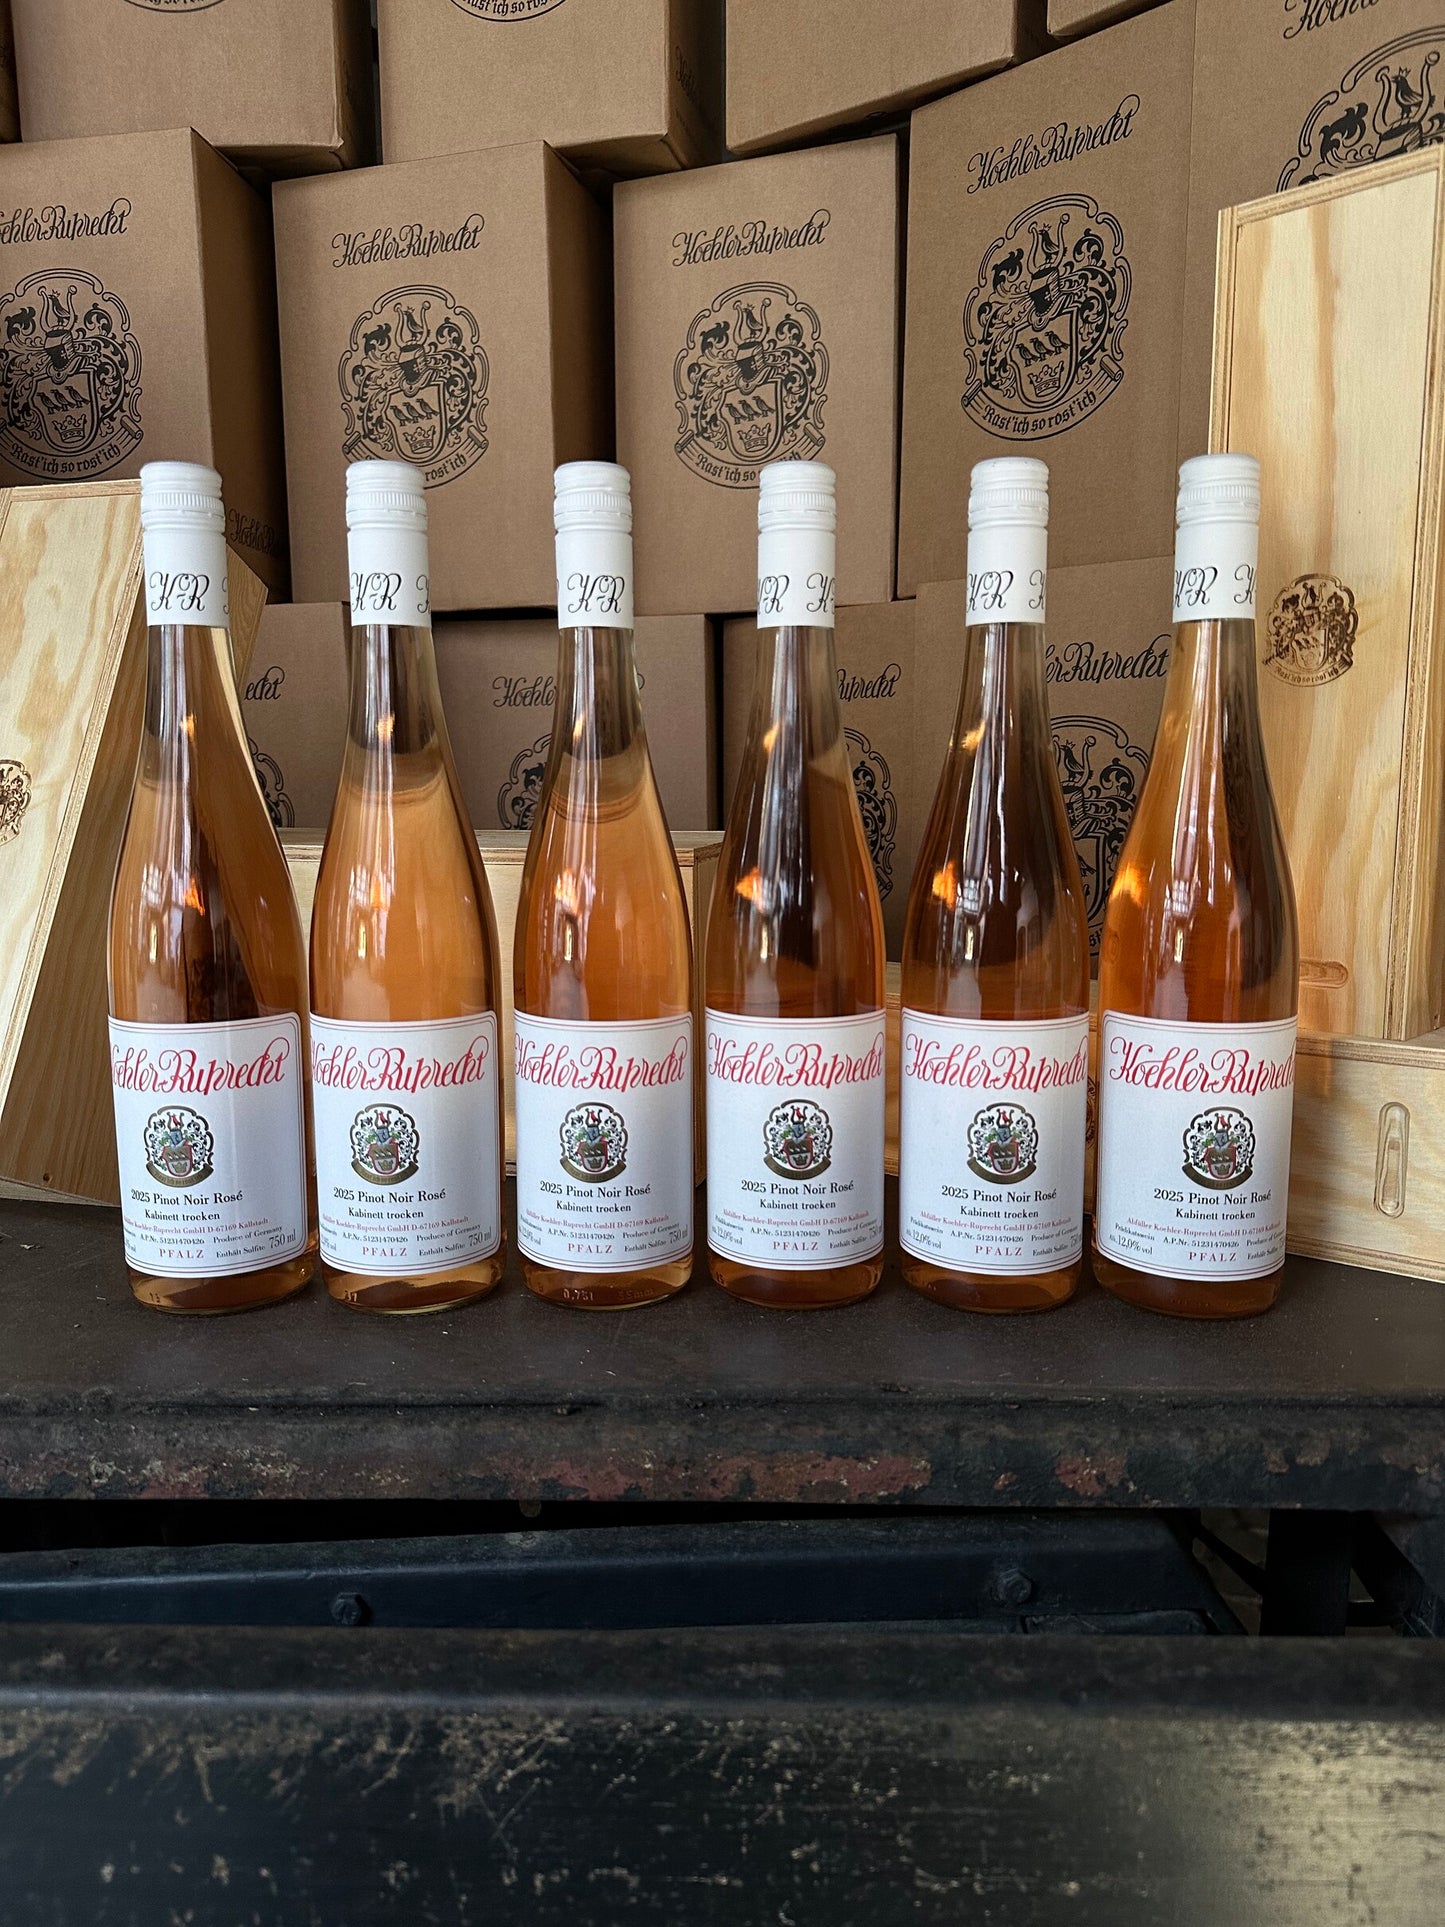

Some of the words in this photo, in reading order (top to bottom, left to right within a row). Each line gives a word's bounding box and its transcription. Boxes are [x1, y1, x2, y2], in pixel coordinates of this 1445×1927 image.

[1031, 420, 1045, 431] so
[60, 464, 75, 473] so
[540, 1180, 562, 1194] 2025
[566, 1185, 593, 1198] Pinot
[597, 1187, 622, 1198] Noir
[625, 1183, 651, 1197] Rosé
[741, 1180, 766, 1193] 2025
[770, 1183, 799, 1195] Pinot
[803, 1184, 826, 1194] Noir
[830, 1180, 854, 1193] Rosé
[941, 1185, 968, 1199] 2025
[973, 1190, 1002, 1203] Pinot
[1007, 1191, 1031, 1203] Noir
[1034, 1188, 1057, 1201] Rosé
[131, 1189, 150, 1203] 2025
[153, 1193, 179, 1205] Pinot
[184, 1194, 210, 1206] Noir
[214, 1190, 243, 1204] Rosé
[334, 1187, 354, 1200] 2025
[358, 1191, 384, 1203] Pinot
[388, 1192, 414, 1203] Noir
[418, 1188, 446, 1202] Rosé
[1153, 1188, 1184, 1203] 2025
[1189, 1192, 1219, 1205] Pinot
[1224, 1194, 1247, 1205] Noir
[1250, 1190, 1271, 1203] Rosé
[556, 1200, 593, 1213] Kabinett
[596, 1202, 631, 1212] trocken
[759, 1199, 798, 1210] Kabinett
[801, 1200, 836, 1210] trocken
[960, 1205, 1000, 1218] Kabinett
[1004, 1209, 1038, 1218] trocken
[145, 1209, 179, 1221] Kabinett
[182, 1211, 220, 1221] trocken
[348, 1207, 383, 1219] Kabinett
[387, 1209, 424, 1219] trocken
[1175, 1208, 1218, 1220] Kabinett
[1222, 1210, 1255, 1220] trocken
[269, 1234, 285, 1249] 750
[287, 1229, 296, 1243] ml
[468, 1232, 483, 1247] 750
